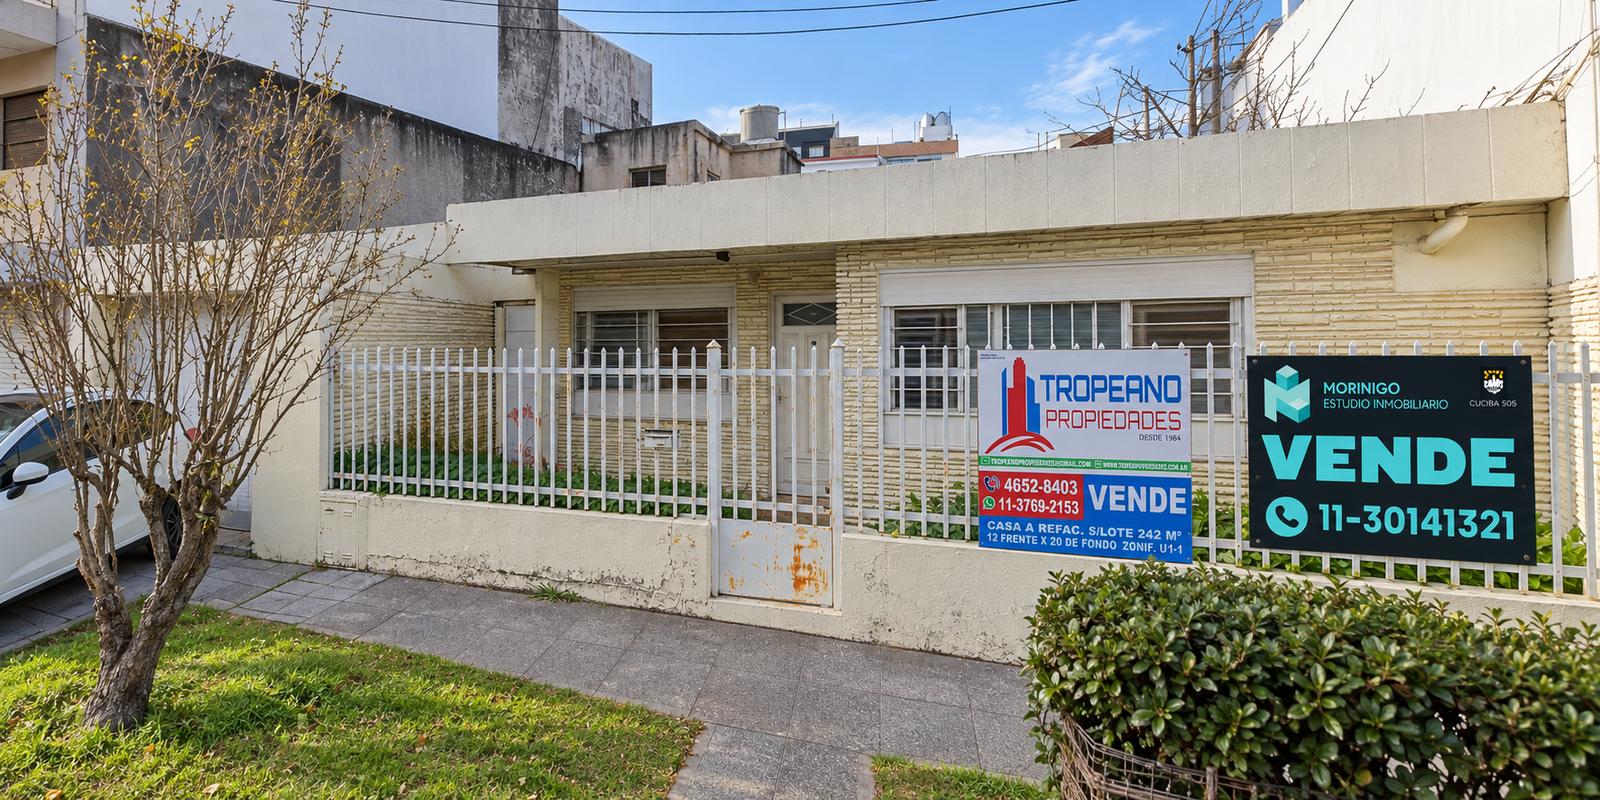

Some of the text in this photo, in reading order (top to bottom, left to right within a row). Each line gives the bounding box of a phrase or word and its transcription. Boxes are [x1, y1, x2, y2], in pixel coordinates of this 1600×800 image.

[1039, 374, 1182, 404] TROPEANO
[1323, 382, 1400, 395] MORINIGO
[1323, 398, 1449, 411] ESTUDIO INMOBILIARIO
[1469, 399, 1500, 407] CUCIBA
[1045, 409, 1182, 431] PROPIEDADES
[1139, 433, 1182, 442] DESDE 1984
[1261, 434, 1516, 488] VENDE
[1003, 477, 1078, 496] 4652-8403
[998, 497, 1080, 515] 11-3769-2153
[1087, 484, 1187, 515] VENDE
[987, 520, 1021, 532] CASA
[1025, 522, 1035, 533] A
[1038, 523, 1084, 536] REFAC.
[1088, 526, 1134, 538] S/LOTE
[1138, 529, 1162, 540] 242
[1318, 503, 1516, 541] 11-30141321
[987, 532, 1182, 555] 12 FRENTE X 20 DE FONDO ZONIF. U1-1
